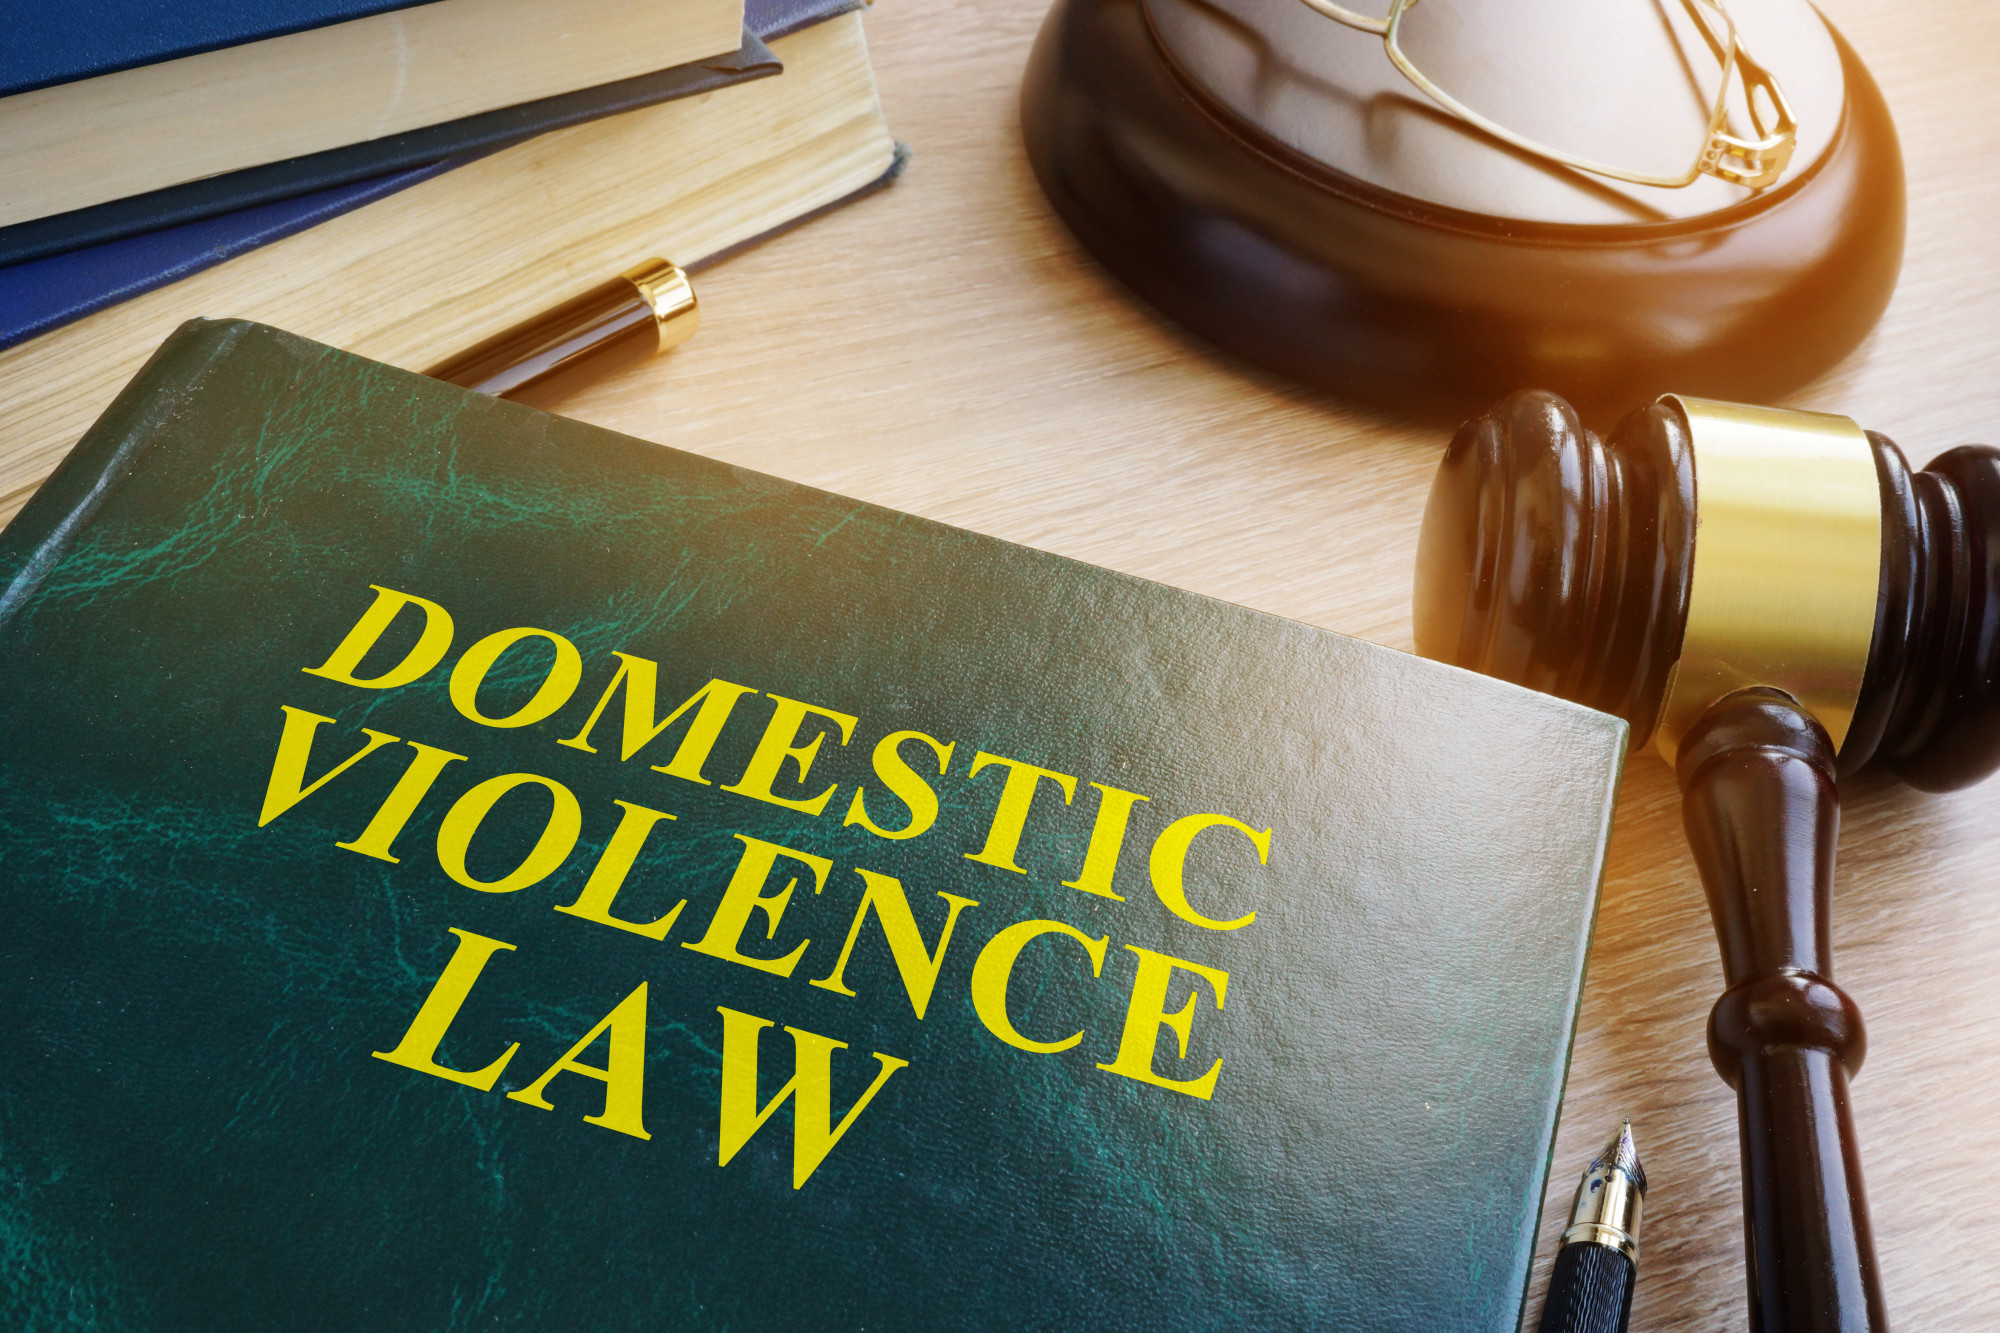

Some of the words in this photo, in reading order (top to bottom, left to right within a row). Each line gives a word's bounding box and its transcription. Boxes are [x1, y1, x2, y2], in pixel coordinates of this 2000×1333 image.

[257, 704, 1230, 1101] VIOLENCE
[301, 584, 1273, 931] DOMESTIC
[371, 926, 909, 1190] LAW
